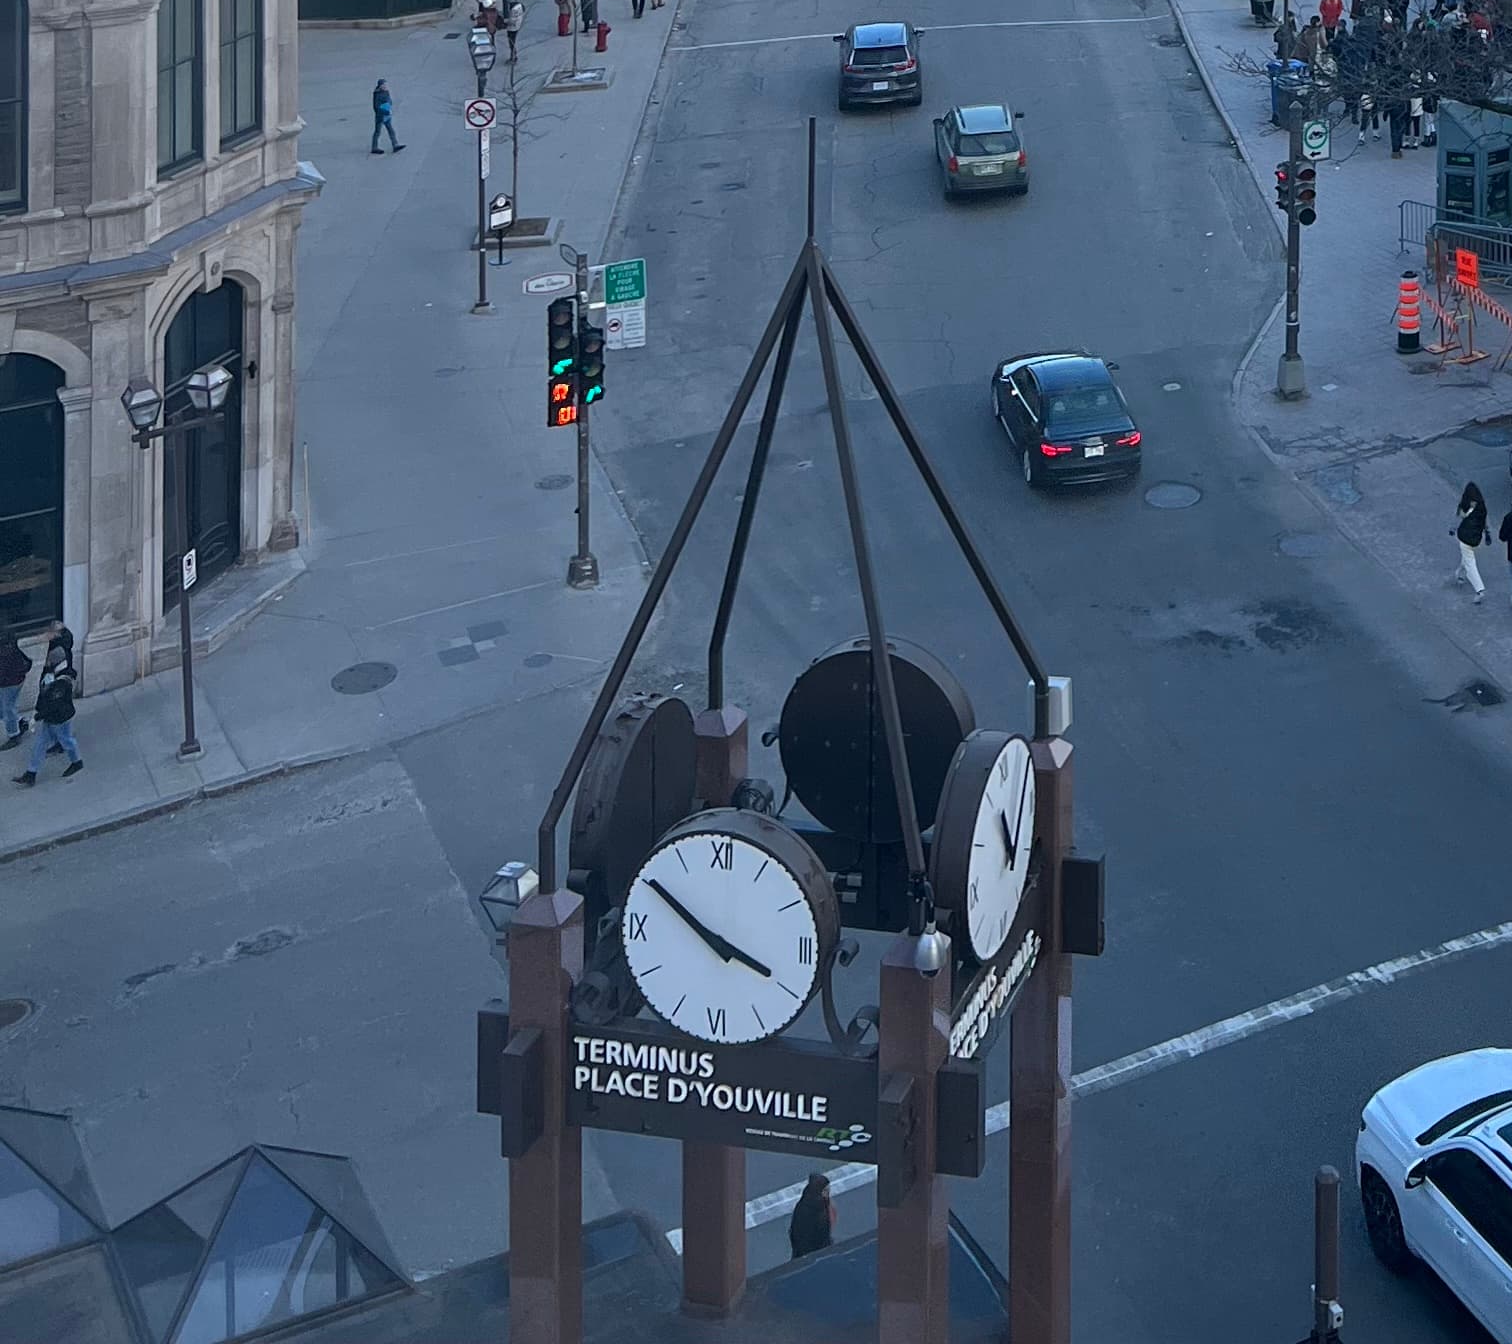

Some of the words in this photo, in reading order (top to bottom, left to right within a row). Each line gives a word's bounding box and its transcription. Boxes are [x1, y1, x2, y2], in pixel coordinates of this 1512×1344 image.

[711, 840, 733, 871] XII
[629, 912, 648, 942] IX
[799, 936, 812, 965] III
[706, 1007, 726, 1037] VI
[573, 1036, 714, 1078] TERMINUS
[574, 1066, 659, 1100] PLACE
[667, 1077, 828, 1122] D'YOUVILLE
